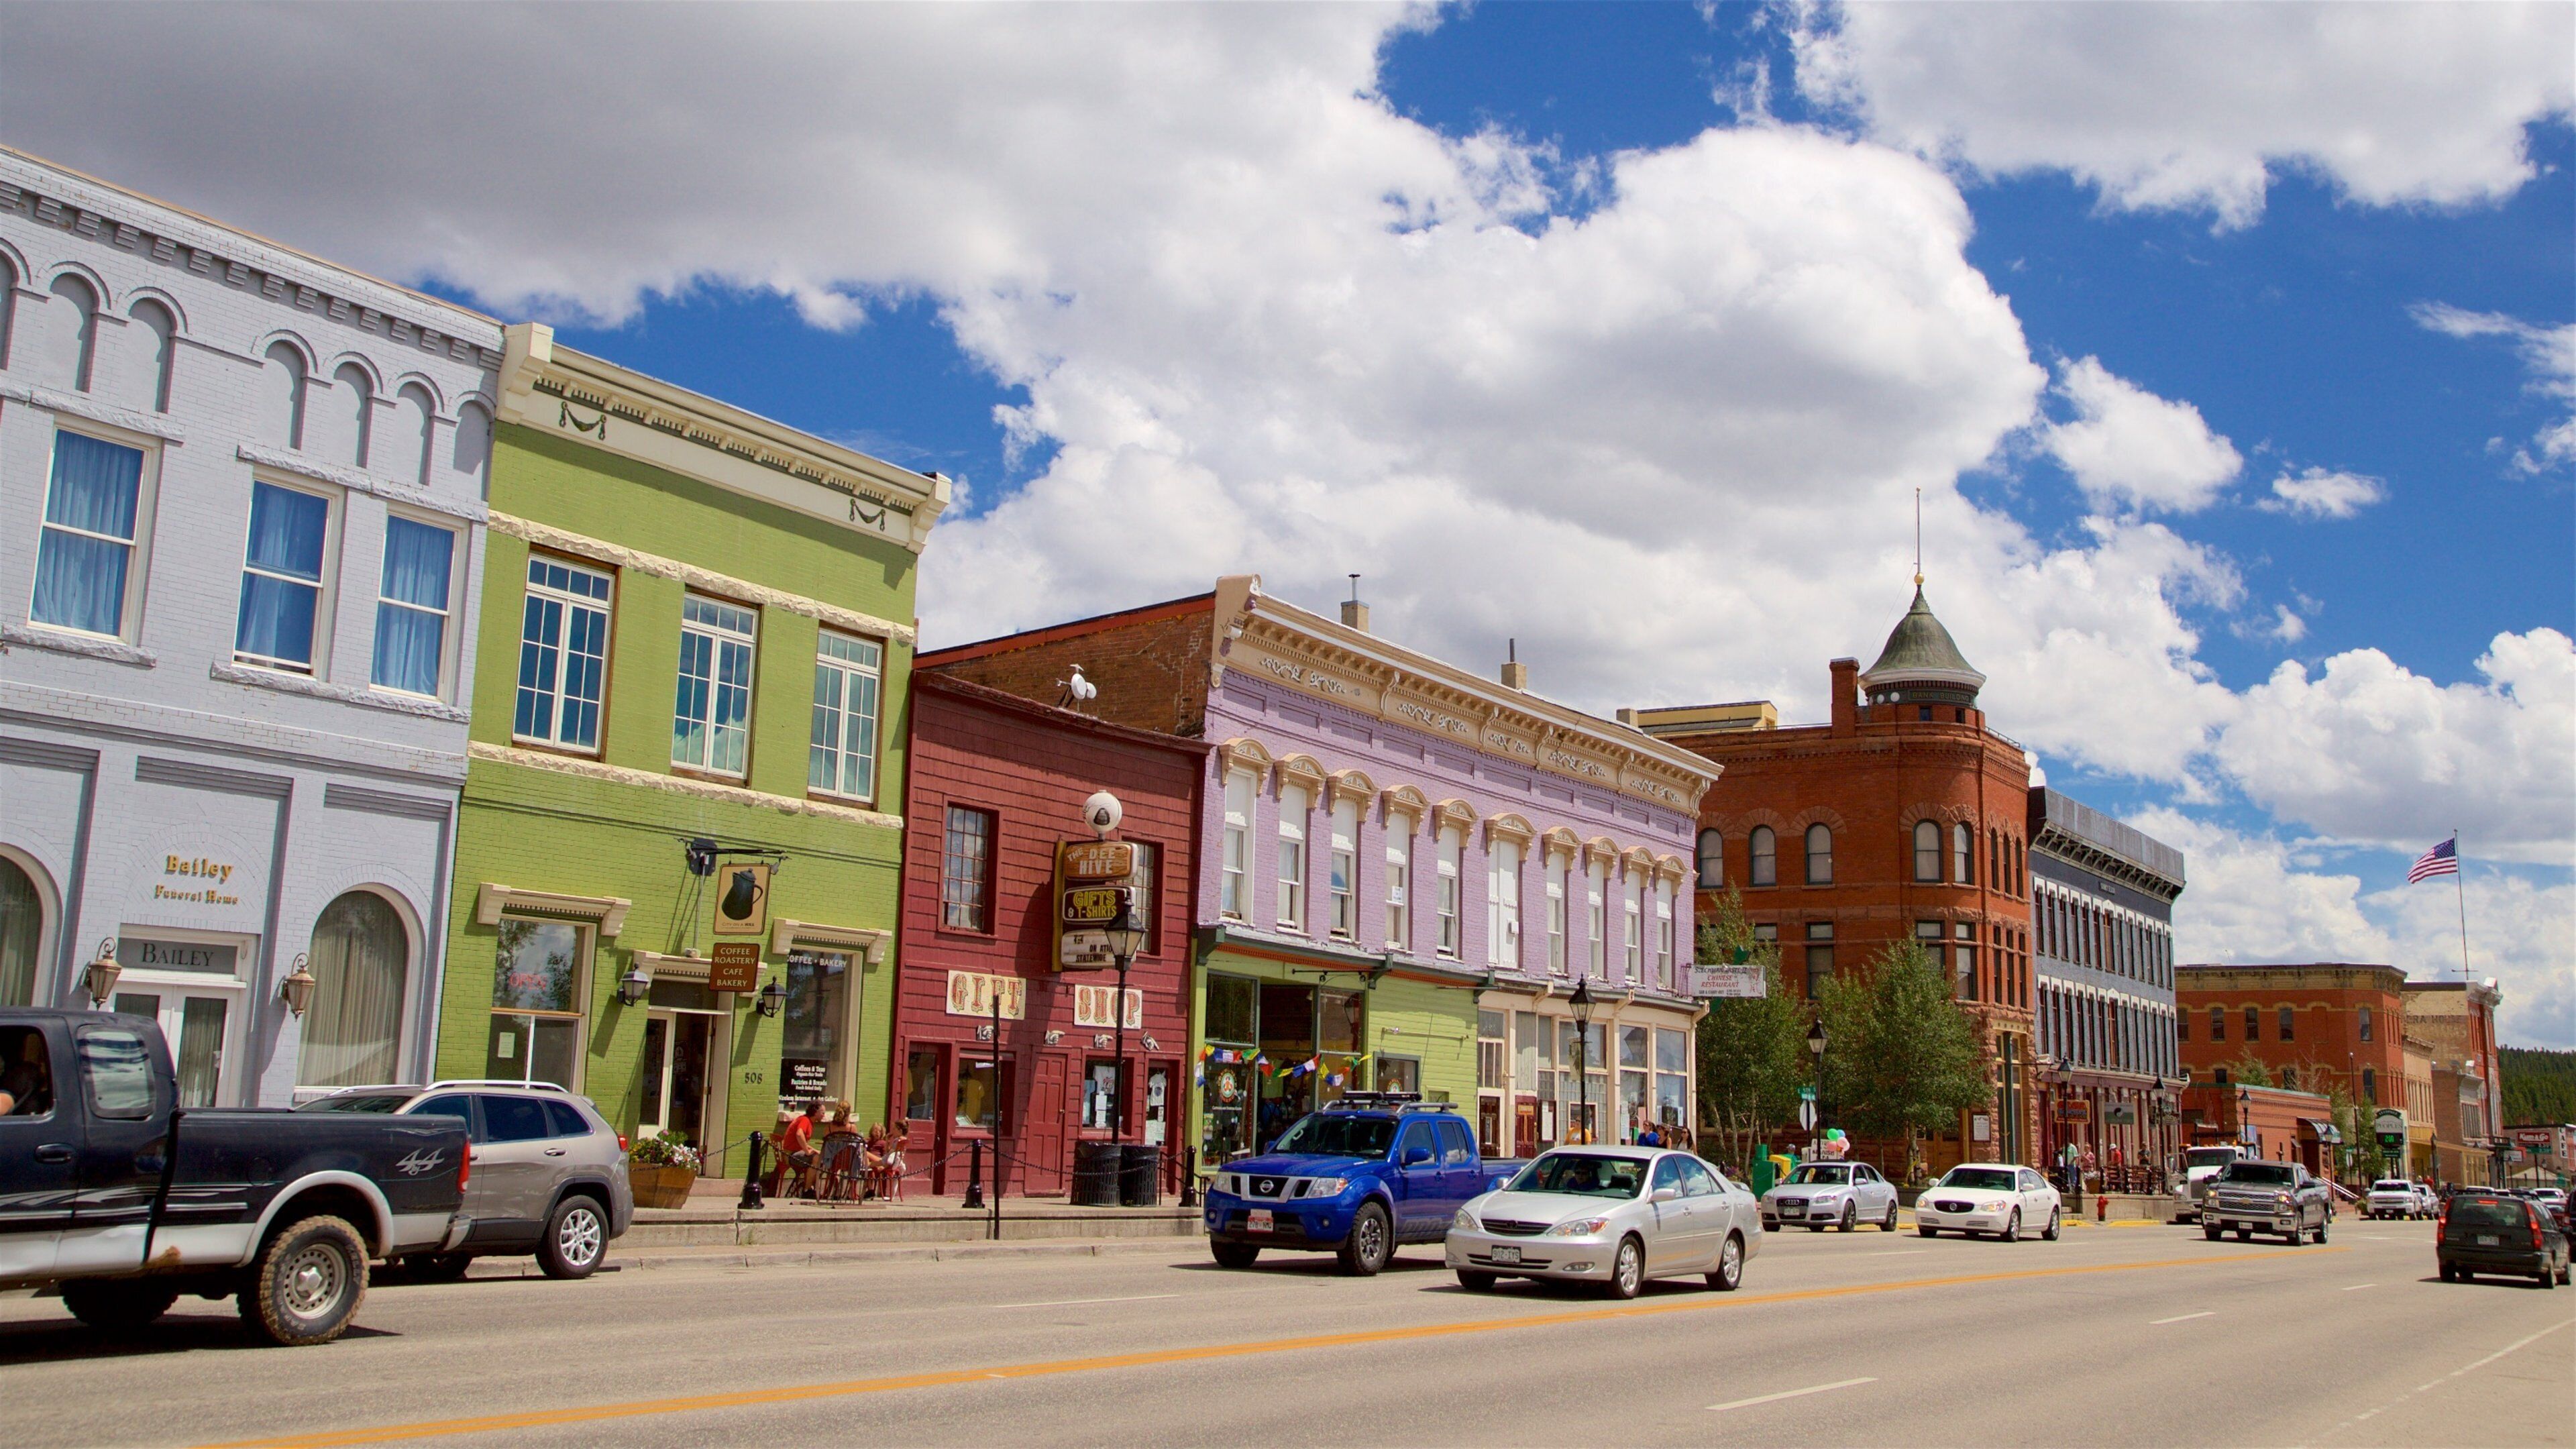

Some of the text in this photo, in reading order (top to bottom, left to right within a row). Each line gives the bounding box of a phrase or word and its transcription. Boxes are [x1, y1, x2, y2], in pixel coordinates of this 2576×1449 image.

[1067, 847, 1116, 862] THE DEE
[166, 855, 234, 883] Bailey
[1079, 859, 1113, 875] HIVE
[154, 884, 239, 905] Funeral Home
[1073, 890, 1116, 908] GIFTS
[1076, 905, 1118, 918] T-SHIRTS
[142, 942, 214, 967] BAILEY
[714, 956, 756, 965] ROASTERY
[1075, 953, 1107, 963] STATEWIDE
[819, 957, 847, 968] BAKERY
[508, 971, 548, 991] OPEN
[716, 979, 747, 987] BAKERY
[951, 973, 1022, 1016] GIFT
[1077, 986, 1140, 1026] SHOP
[794, 1065, 812, 1073] Coffees
[816, 1065, 826, 1073] Teas
[744, 1072, 763, 1085] 508
[824, 1095, 839, 1104] Gallery
[2539, 1133, 2549, 1141] Go
[2559, 1127, 2567, 1158] CAFE
